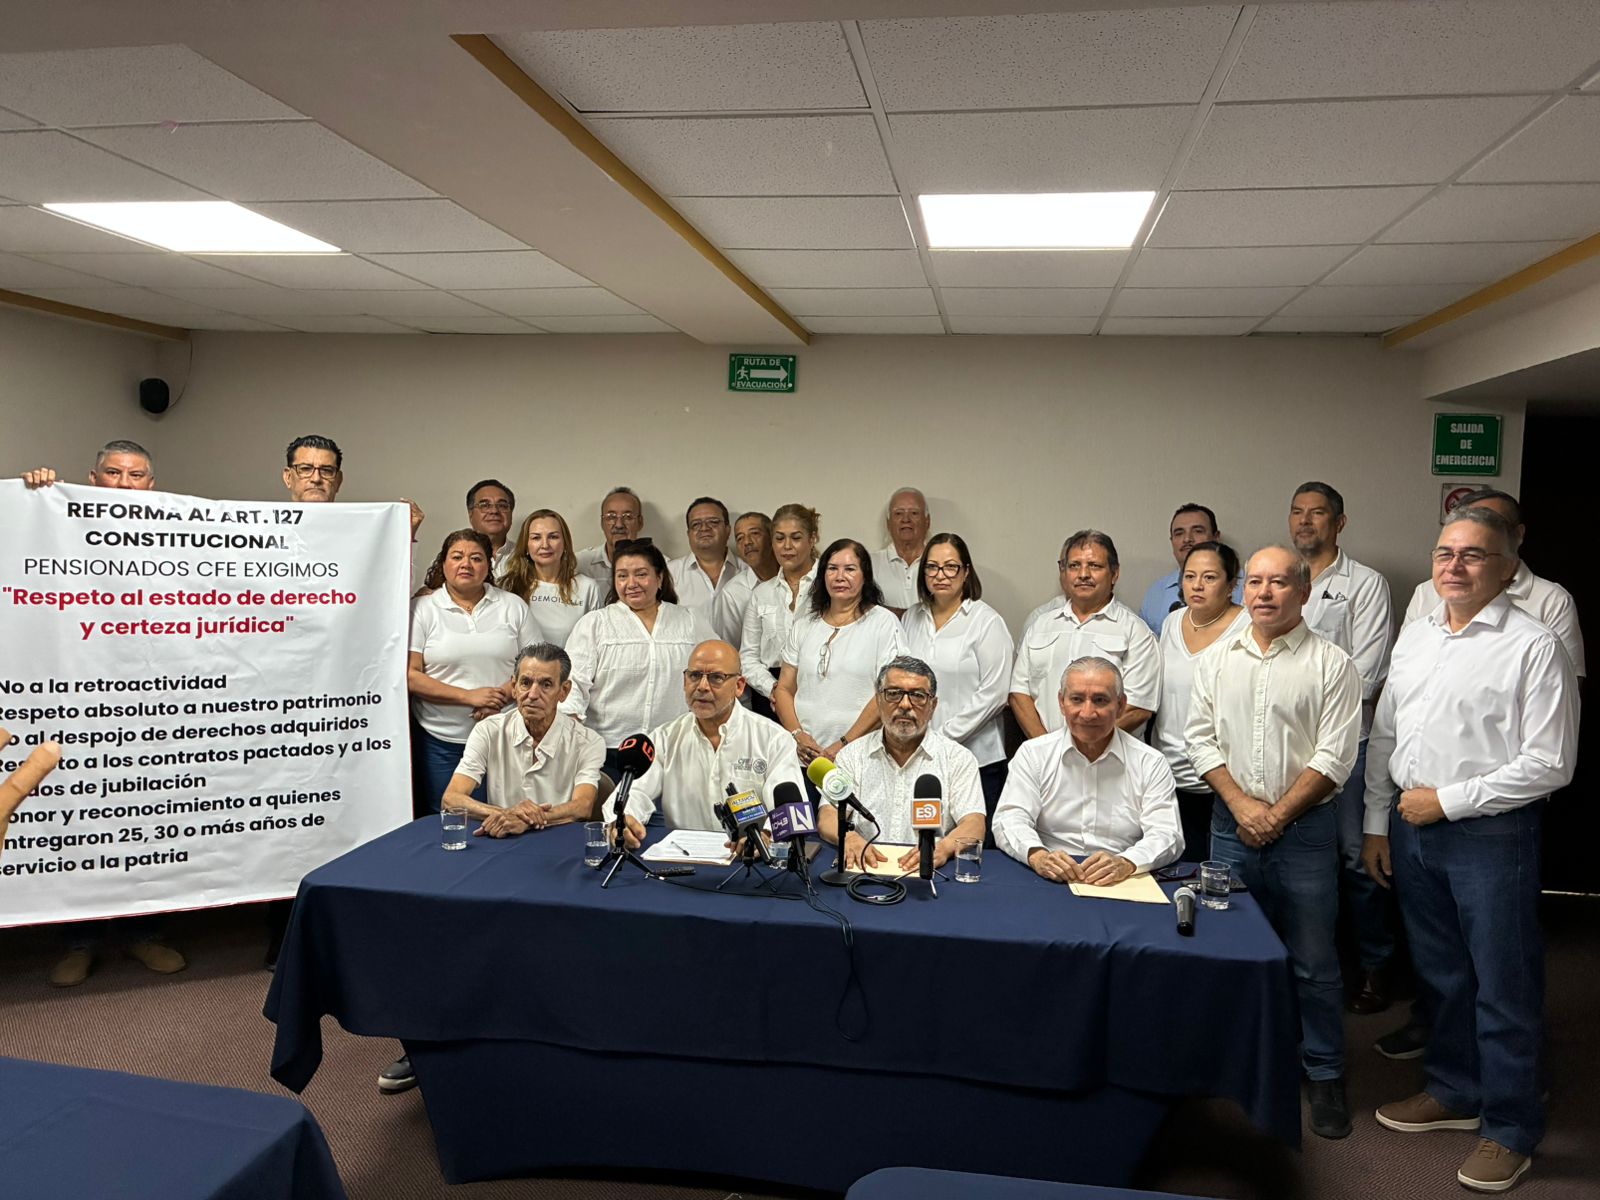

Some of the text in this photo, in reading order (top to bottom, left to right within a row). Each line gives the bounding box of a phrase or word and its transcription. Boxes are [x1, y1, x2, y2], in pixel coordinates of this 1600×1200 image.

[744, 358, 766, 366] RUTA
[1450, 423, 1485, 434] SALIDA
[1460, 439, 1473, 450] DE
[1436, 455, 1495, 466] EMERGENCIA
[68, 502, 303, 524] REFORMA AL ART. 127
[85, 531, 288, 549] CONSTITUCIONAL
[25, 559, 338, 577] PENSIONADOS CFE EXIGIMOS
[3, 587, 356, 611] "Respeto al estado de derecho
[80, 616, 294, 640] y certeza jurídica"
[29, 682, 43, 694] a
[49, 679, 68, 693] la
[75, 675, 226, 693] retroactividad
[84, 702, 179, 718] absoluto
[183, 703, 196, 715] a
[202, 698, 278, 714] nuestro
[283, 691, 382, 714] patrimonio
[25, 730, 45, 746] al
[50, 727, 136, 748] despojo
[141, 727, 168, 741] de
[172, 723, 266, 740] derechos
[270, 716, 368, 737] adquiridos
[84, 757, 97, 769] a
[103, 754, 133, 768] los
[138, 749, 238, 766] contratos
[243, 742, 334, 765] pactados
[338, 743, 348, 758] y
[351, 741, 362, 752] a
[366, 737, 391, 751] los
[70, 780, 97, 795] de
[100, 773, 206, 798] jubilación
[9, 790, 341, 826] onor y reconocimiento a quienes
[4, 813, 325, 852] ntregaron 25, 30 o más años de
[0, 848, 188, 876] ervicio a la patria
